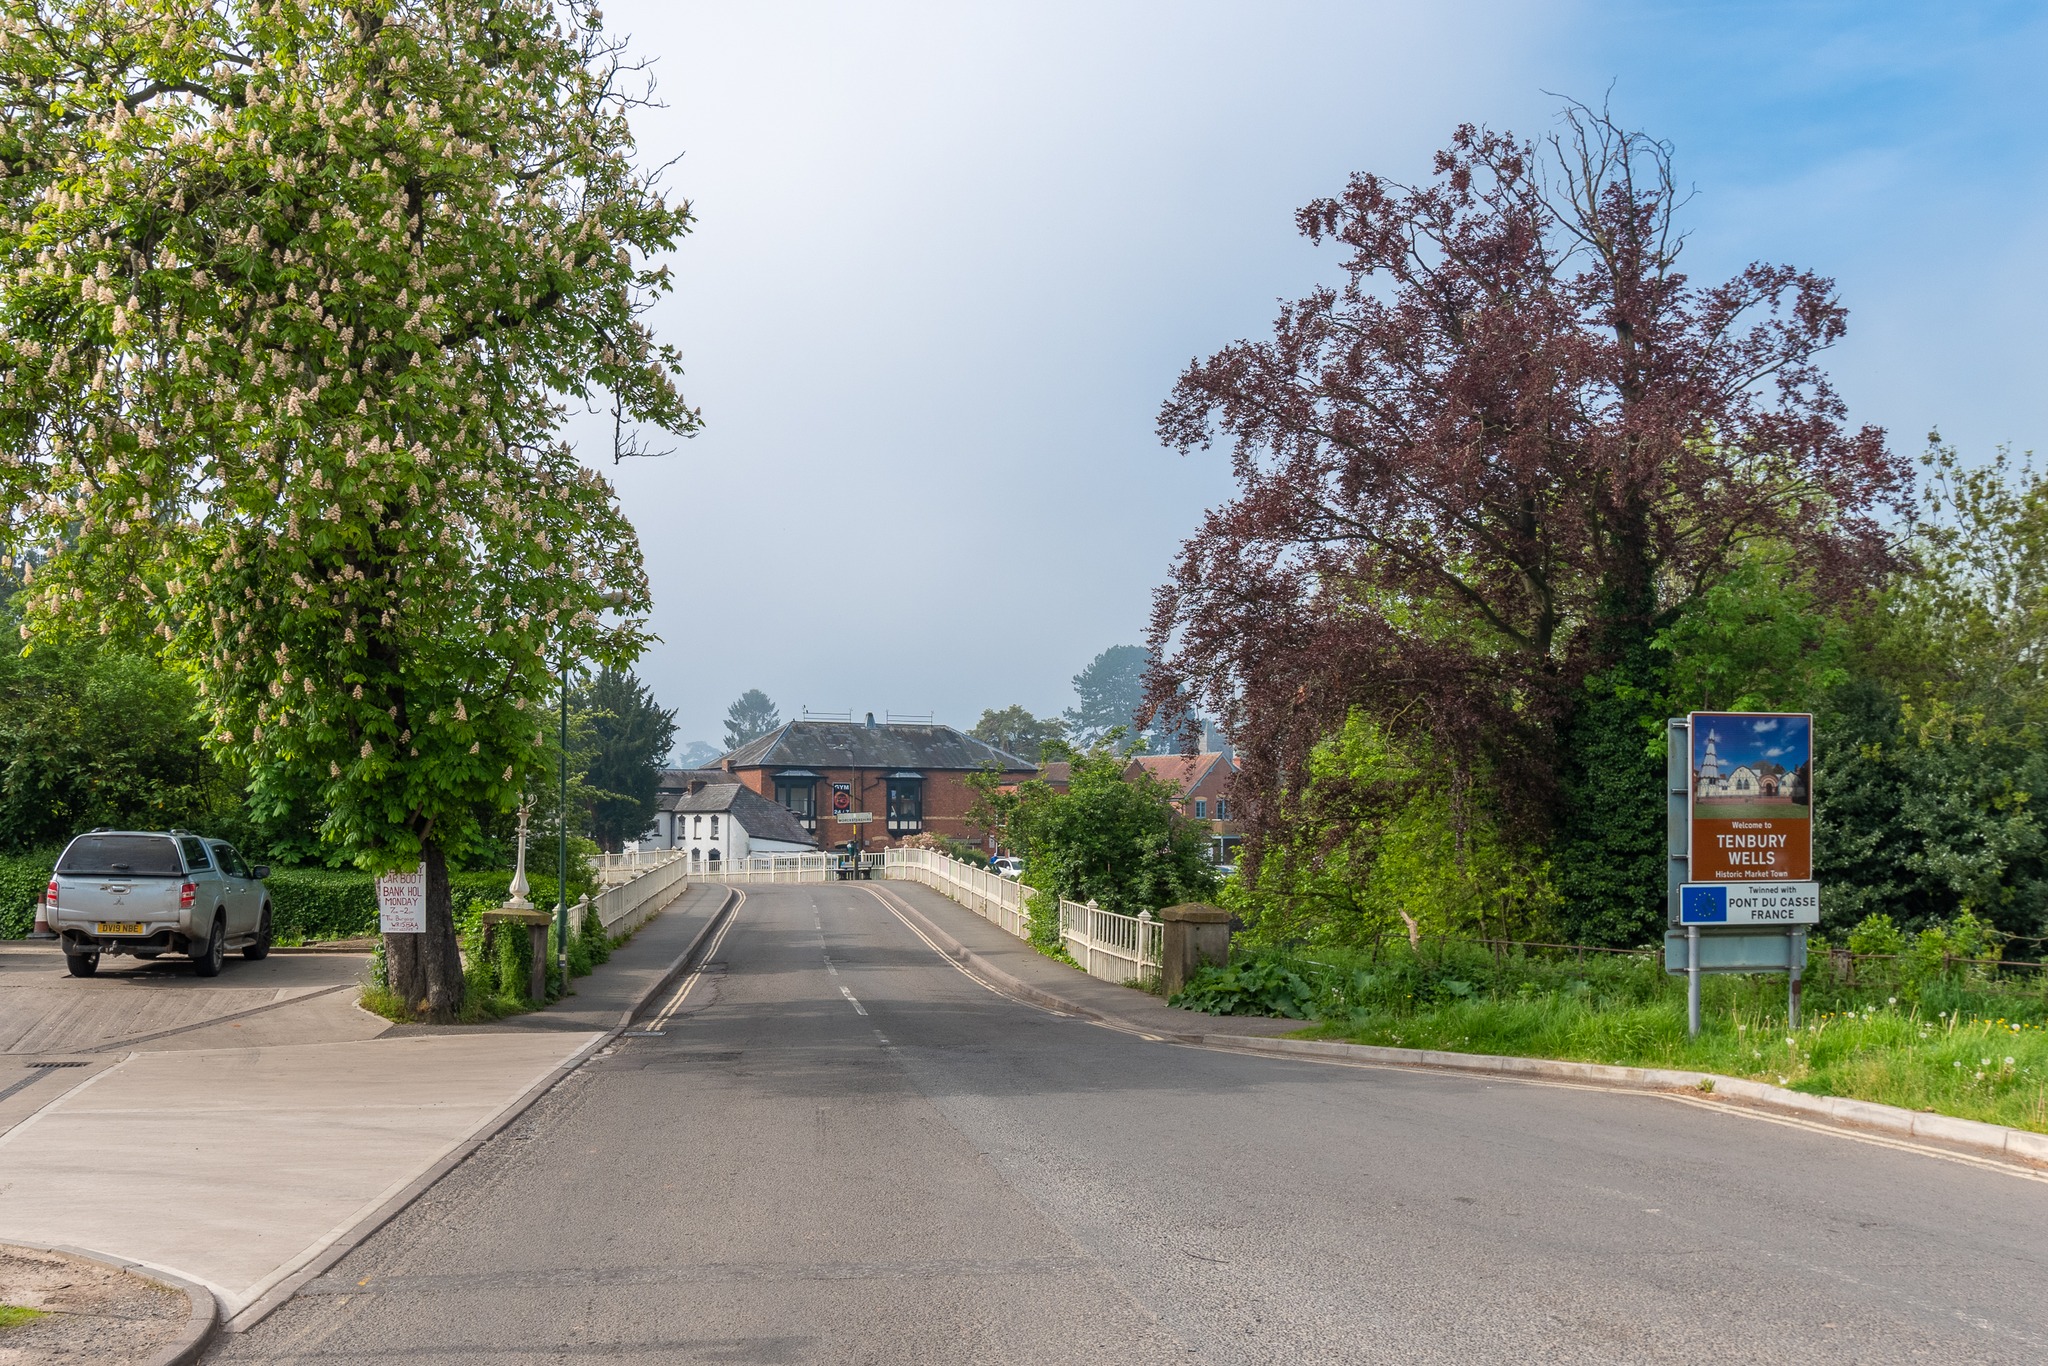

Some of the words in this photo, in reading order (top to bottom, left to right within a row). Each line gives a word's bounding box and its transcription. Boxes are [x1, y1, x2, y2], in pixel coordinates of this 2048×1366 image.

[1732, 821, 1763, 829] Welcome
[1764, 821, 1772, 829] to
[1717, 834, 1787, 848] TENBURY
[1728, 851, 1775, 865] WELLS
[383, 874, 398, 884] CAR
[400, 874, 423, 884] BOOT
[1715, 870, 1742, 878] Historic
[1744, 870, 1769, 878] Market
[383, 886, 405, 897] BANK
[408, 886, 422, 897] HOL
[1749, 886, 1779, 894] Twinned
[1781, 886, 1797, 894] with
[385, 897, 419, 906] MONDAY
[1729, 898, 1758, 908] PONT
[1762, 898, 1777, 907] DU
[1780, 897, 1816, 907] CASSE
[1751, 909, 1794, 920] FRANCE
[102, 924, 121, 932] DV19
[122, 924, 139, 932] NBE
